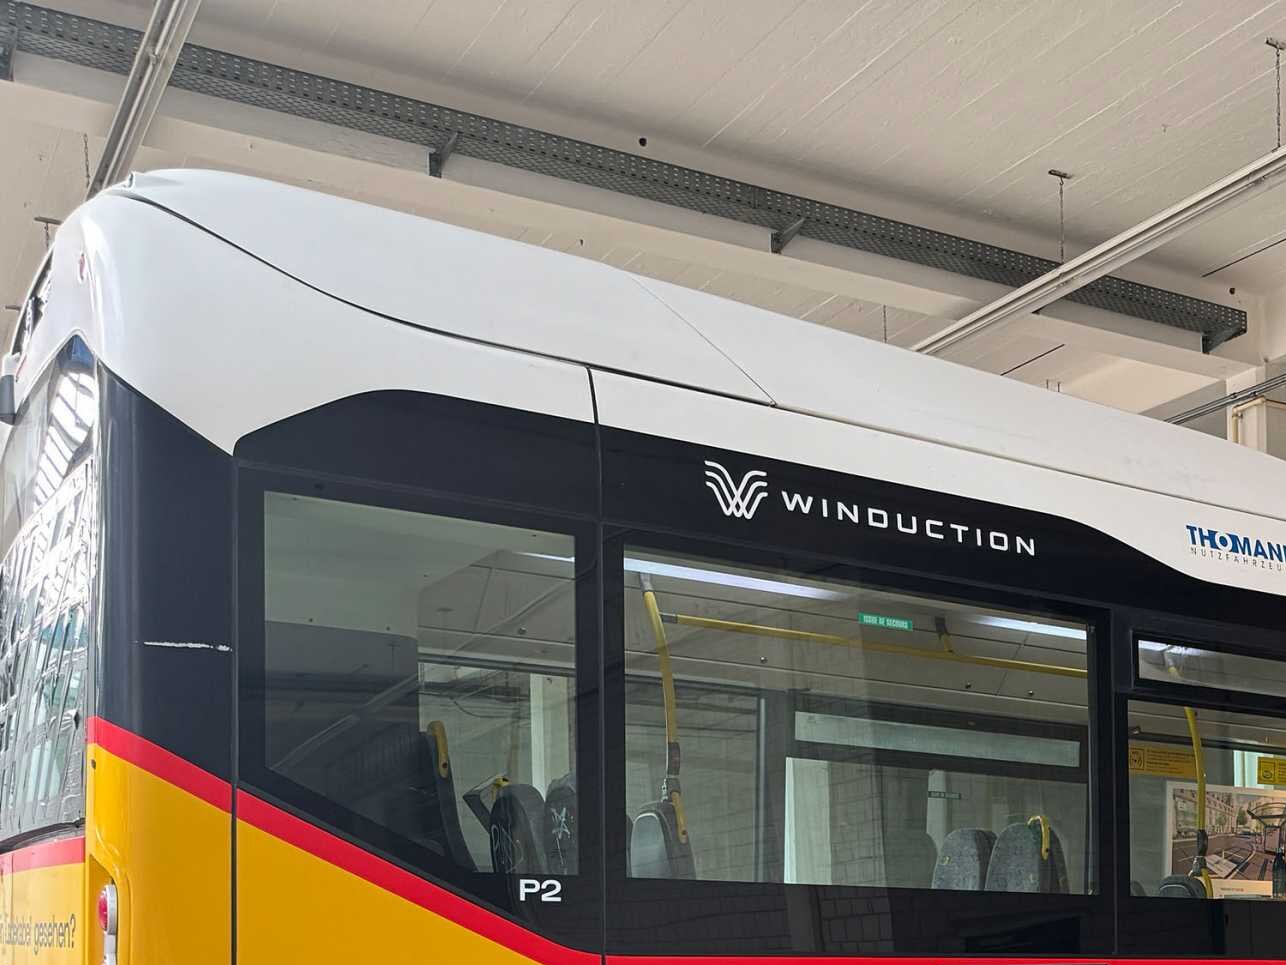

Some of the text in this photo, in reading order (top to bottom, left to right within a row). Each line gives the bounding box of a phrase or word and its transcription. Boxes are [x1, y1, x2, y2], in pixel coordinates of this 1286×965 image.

[781, 490, 1035, 557] WINDUCTION
[519, 878, 562, 902] P2
[34, 913, 77, 956] gesehen?
